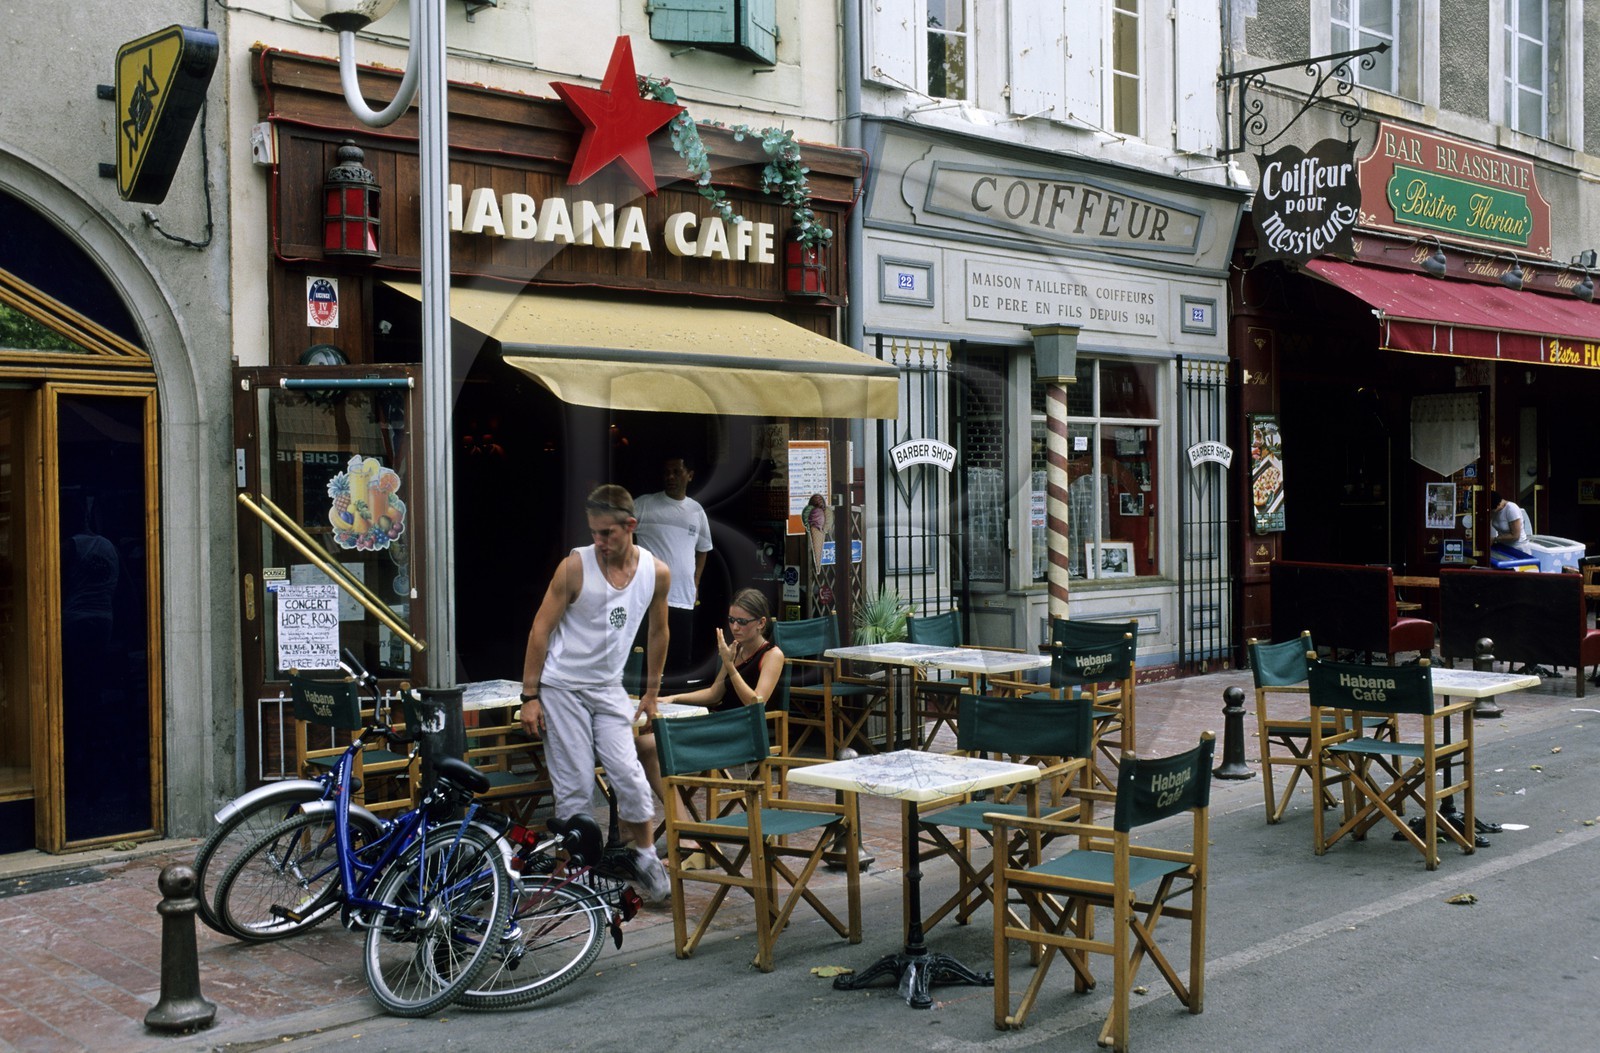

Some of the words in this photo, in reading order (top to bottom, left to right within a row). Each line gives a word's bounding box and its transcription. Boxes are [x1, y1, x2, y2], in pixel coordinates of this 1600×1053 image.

[1384, 132, 1424, 165] BAR
[1436, 145, 1530, 190] BRASSERIE
[1262, 157, 1352, 201] Coiffeur
[971, 176, 1170, 242] COIFFEUR
[1285, 197, 1327, 215] pour
[1402, 179, 1457, 222] Bistro
[1466, 193, 1527, 236] Florian
[664, 211, 775, 264] CAFE
[900, 275, 912, 287] 22
[972, 272, 1021, 290] MAISON
[1027, 279, 1088, 297] TAILLEFER
[1096, 287, 1154, 305] COIFFEURS
[972, 294, 989, 308] DE
[997, 297, 1028, 313] PERE
[1036, 302, 1051, 315] EN
[1058, 304, 1082, 318] FILS
[1089, 308, 1129, 323] DEPUIS
[1135, 313, 1155, 326] 1941
[1193, 309, 1203, 321] 22
[1549, 340, 1580, 364] Bistro
[896, 444, 929, 464] BARBER
[932, 445, 953, 463] SHOP
[1191, 445, 1215, 461] BARBER
[1216, 446, 1231, 461] SHOP
[285, 599, 331, 610] CONCERT
[281, 612, 309, 627] HOPE
[312, 612, 338, 628] ROAD
[1075, 653, 1112, 668] Habana
[1083, 664, 1105, 677] Café
[1339, 673, 1396, 689] Habana
[303, 690, 335, 705] Habana
[1352, 687, 1387, 702] Café
[312, 703, 334, 717] Café
[1151, 766, 1191, 793] Habana
[1156, 784, 1185, 808] Café
